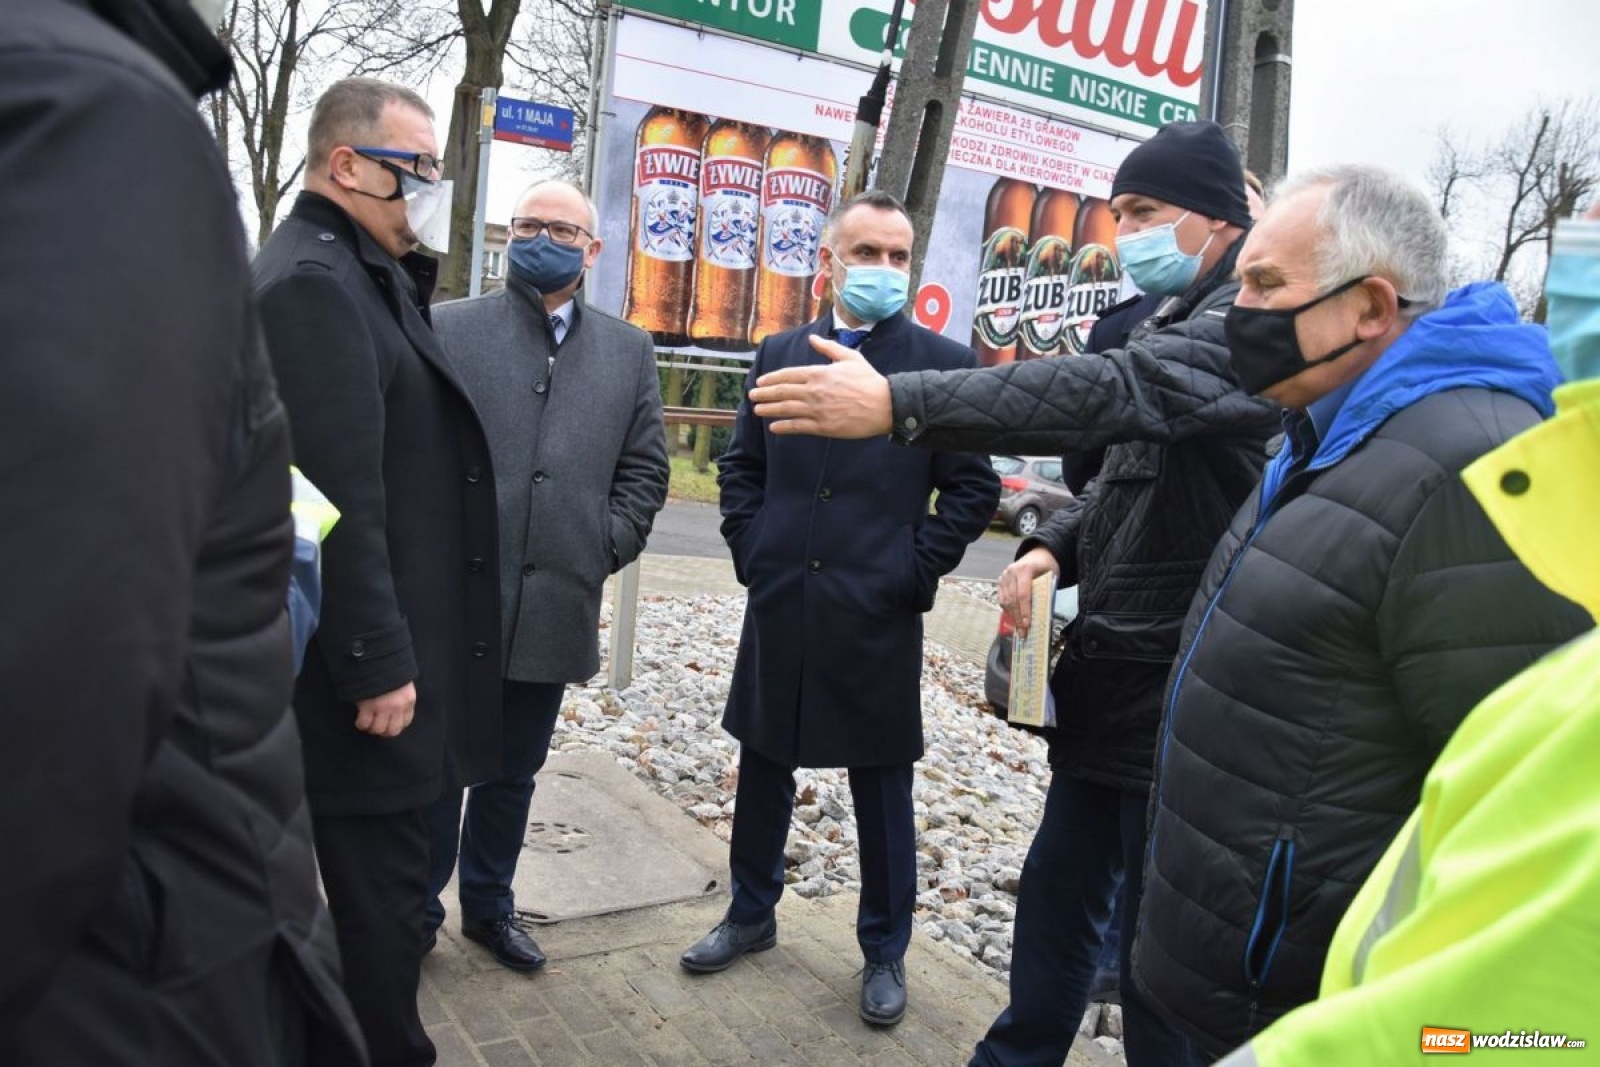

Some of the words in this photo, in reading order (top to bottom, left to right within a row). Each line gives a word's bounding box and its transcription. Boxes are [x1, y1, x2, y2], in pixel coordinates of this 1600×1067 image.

[1069, 75, 1148, 118] NISKIE
[501, 105, 514, 120] ul.
[517, 107, 523, 121] 1
[525, 108, 554, 127] MAJA
[967, 103, 1017, 125] ZAWIERA
[1020, 117, 1032, 129] 25
[990, 144, 1038, 165] ZDROWIU
[1042, 156, 1079, 174] KOBIET
[1081, 166, 1091, 177] W
[995, 158, 1016, 173] DLA
